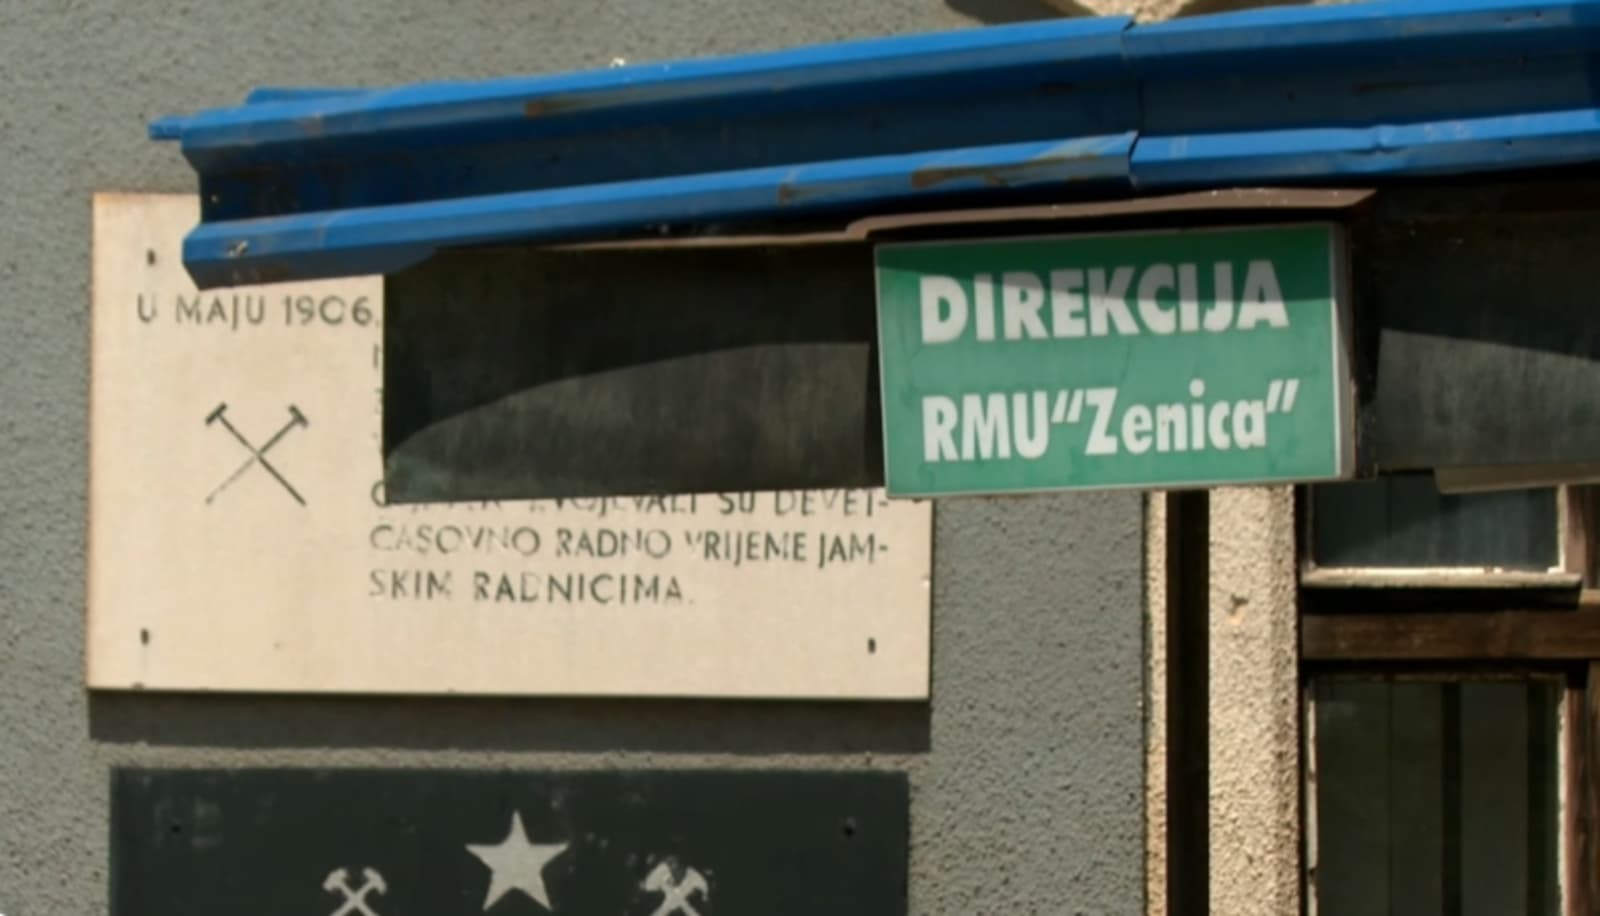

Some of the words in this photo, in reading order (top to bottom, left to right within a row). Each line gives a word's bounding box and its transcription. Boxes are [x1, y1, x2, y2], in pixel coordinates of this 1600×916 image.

[136, 293, 157, 324] U
[175, 294, 266, 331] MAJU
[920, 259, 1289, 344] DIREKCIJA
[555, 527, 672, 559] RADNO
[684, 529, 807, 567] VRIJEME
[817, 532, 888, 569] JAM-
[369, 568, 452, 600] SKIM
